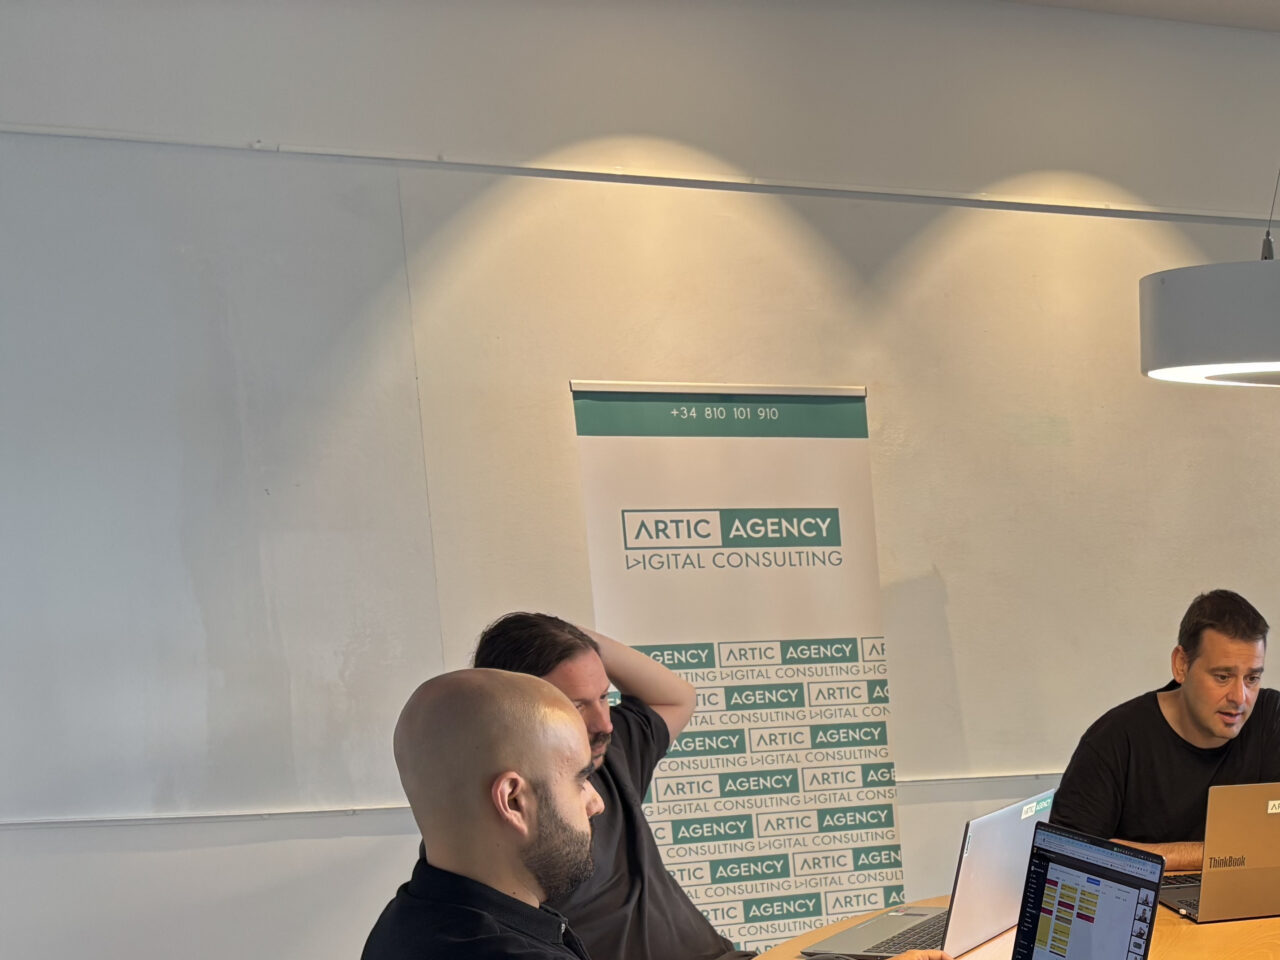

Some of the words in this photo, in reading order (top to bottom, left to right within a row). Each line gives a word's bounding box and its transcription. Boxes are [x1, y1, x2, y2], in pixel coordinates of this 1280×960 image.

[671, 407, 697, 419] +34
[705, 407, 726, 419] 810
[733, 407, 751, 419] 101
[758, 408, 779, 420] 910
[635, 519, 711, 540] ARTIC
[729, 518, 831, 538] AGENCY
[712, 550, 843, 568] CONSULTING
[644, 649, 709, 664] GENCY
[726, 647, 775, 662] ARTIC
[786, 644, 852, 659] AGENCY
[775, 665, 860, 679] CONSULTING
[730, 689, 799, 705] AGENCY
[815, 686, 862, 700] ARTIC
[719, 709, 806, 725] CONSULTING
[670, 735, 739, 752] AGENCY
[757, 731, 805, 747] ARTIC
[815, 728, 881, 743] AGENCY
[658, 756, 748, 772] CONSULTING
[805, 748, 889, 763] CONSULTING
[664, 780, 713, 796] ARTIC
[724, 775, 793, 792] AGENCY
[809, 771, 856, 786] ARTIC
[713, 795, 800, 812] CONSULTING
[678, 820, 747, 839] AGENCY
[764, 816, 812, 832] ARTIC
[823, 810, 888, 827] AGENCY
[666, 842, 755, 858] CONSULTING
[812, 830, 896, 846] CONSULTING
[715, 860, 784, 878] AGENCY
[801, 855, 848, 870] ARTIC
[1209, 855, 1246, 869] ThinkBook
[705, 880, 792, 899] CONSULTING
[749, 899, 816, 918] AGENCY
[832, 893, 879, 909] ARTIC
[738, 919, 823, 938] CONSULTING
